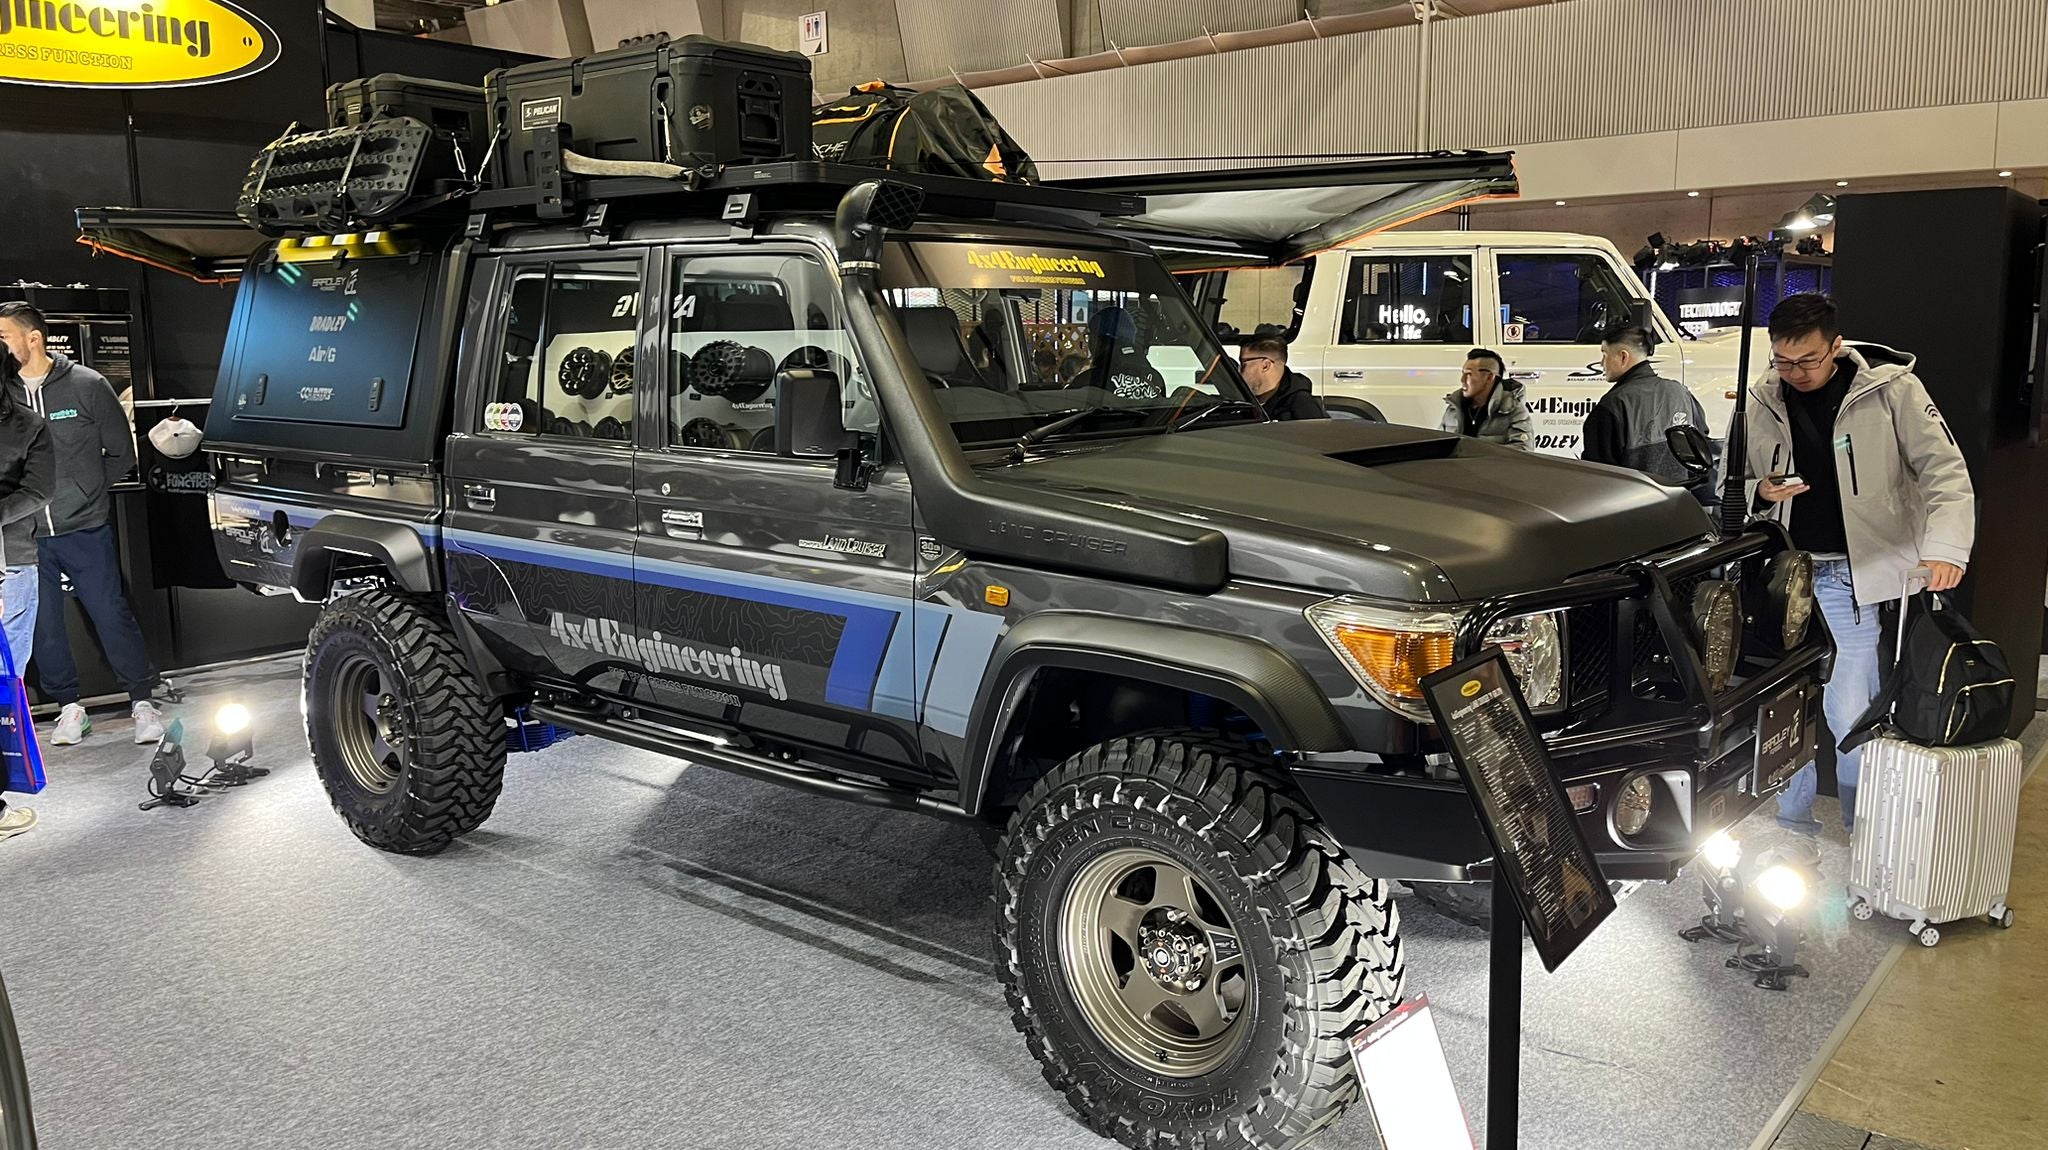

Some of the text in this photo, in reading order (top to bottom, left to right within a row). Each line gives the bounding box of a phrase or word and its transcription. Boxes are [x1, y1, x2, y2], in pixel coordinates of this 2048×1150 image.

[41, 47, 133, 70] FUNCTION
[533, 105, 558, 116] PELICAN
[967, 250, 1105, 279] 4x4Engineering
[312, 276, 347, 287] BRADLEY
[1378, 304, 1431, 326] Hello,
[1679, 302, 1742, 318] TECHNOLOGY
[309, 315, 347, 332] BRADLEY
[308, 345, 337, 363] Air/G
[847, 537, 887, 558] CRUISER
[989, 520, 1128, 557] LAND CRUISER
[550, 611, 788, 701] 4x4Engineering
